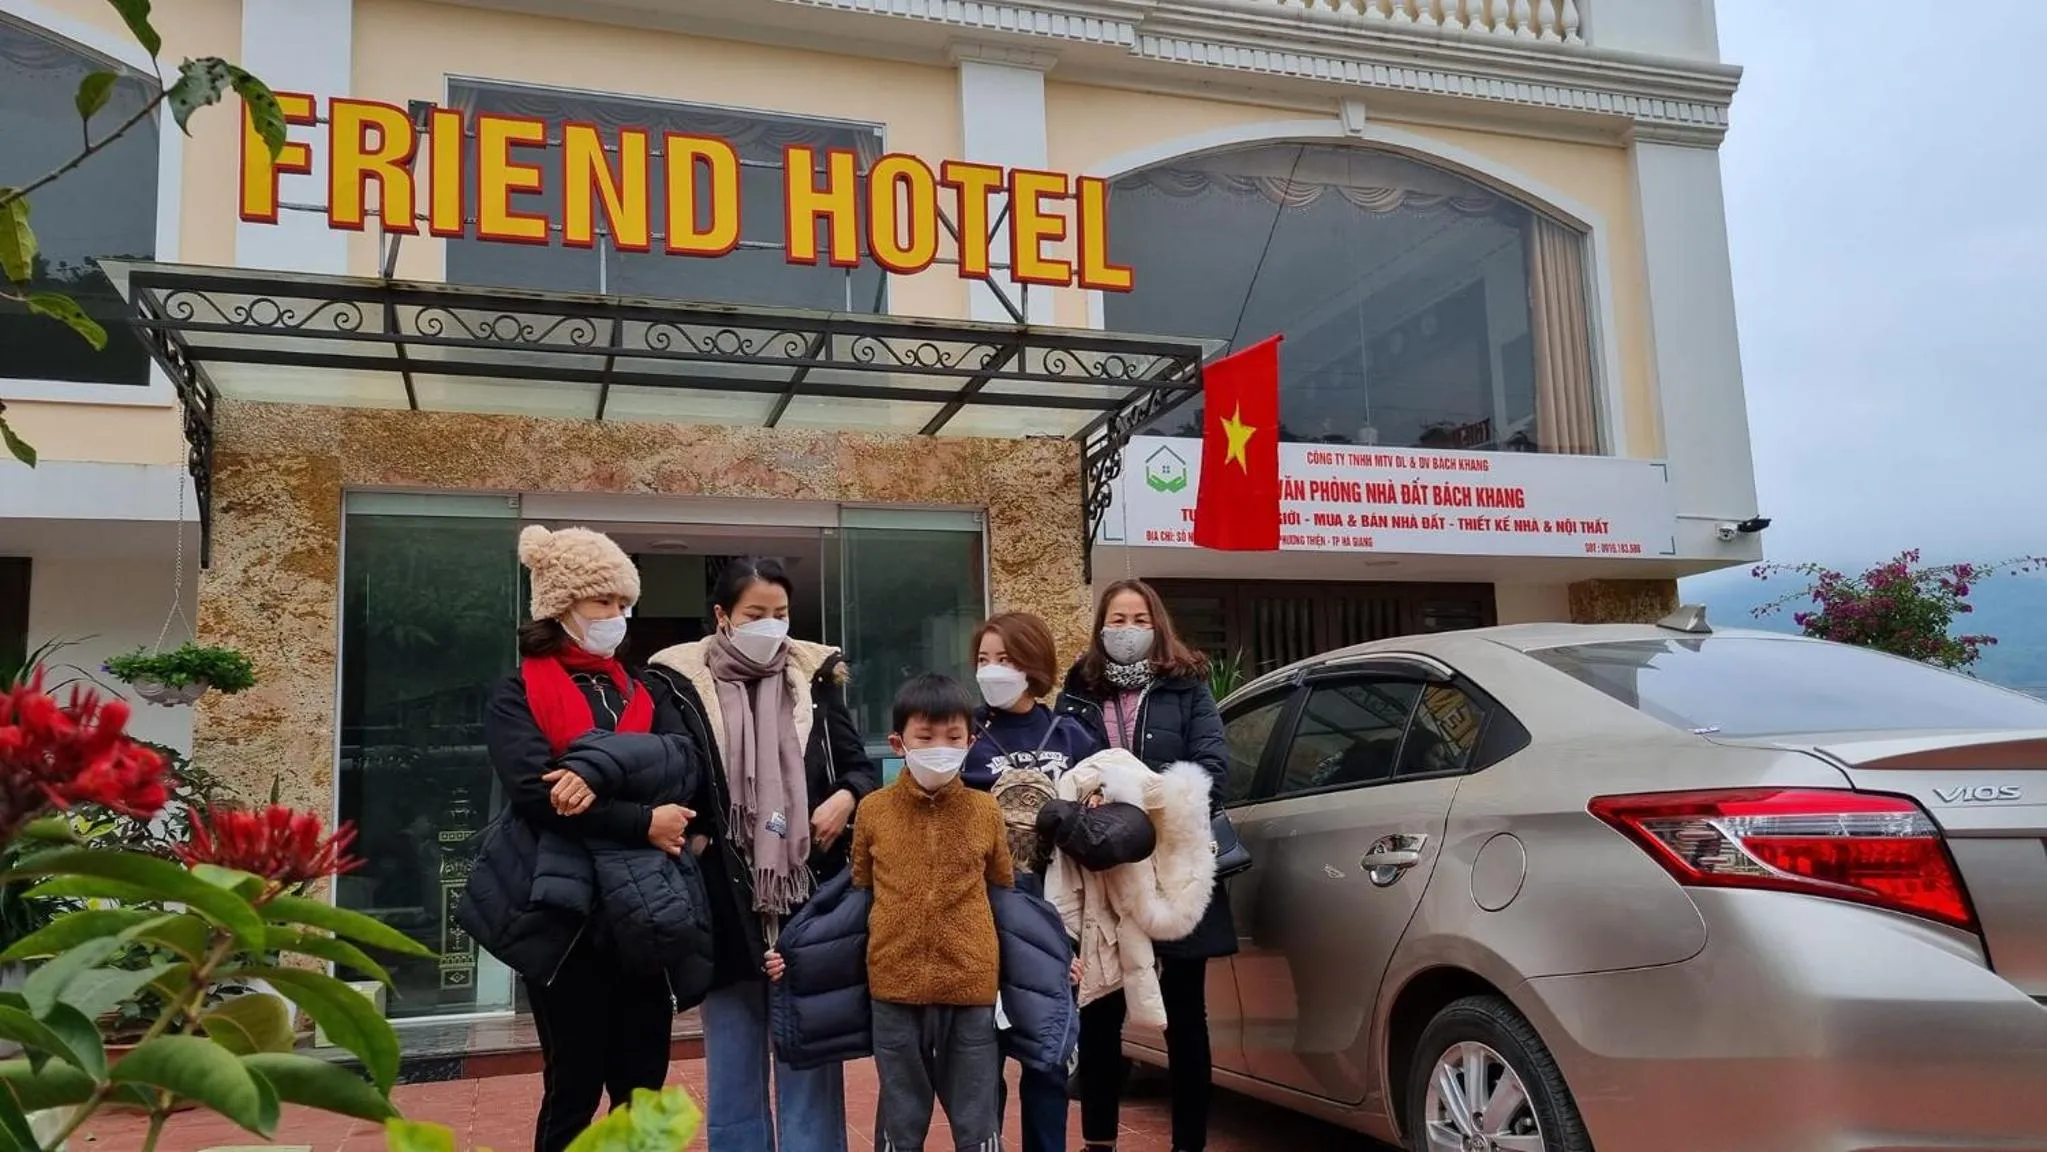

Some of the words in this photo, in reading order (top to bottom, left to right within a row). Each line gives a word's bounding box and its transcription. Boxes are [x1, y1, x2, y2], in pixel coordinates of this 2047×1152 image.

[239, 91, 742, 258] FRIEND
[783, 148, 1135, 294] HOTEL
[1335, 453, 1345, 466] TY
[1348, 453, 1372, 467] TNHH
[1374, 455, 1393, 468] MTV
[1409, 457, 1416, 469] &
[1458, 458, 1489, 472] KHANG
[1475, 486, 1525, 508] KHANG
[1313, 512, 1343, 527] MUA
[1347, 514, 1357, 527] &
[1543, 520, 1552, 533] &
[1932, 784, 2022, 803] VIOS
